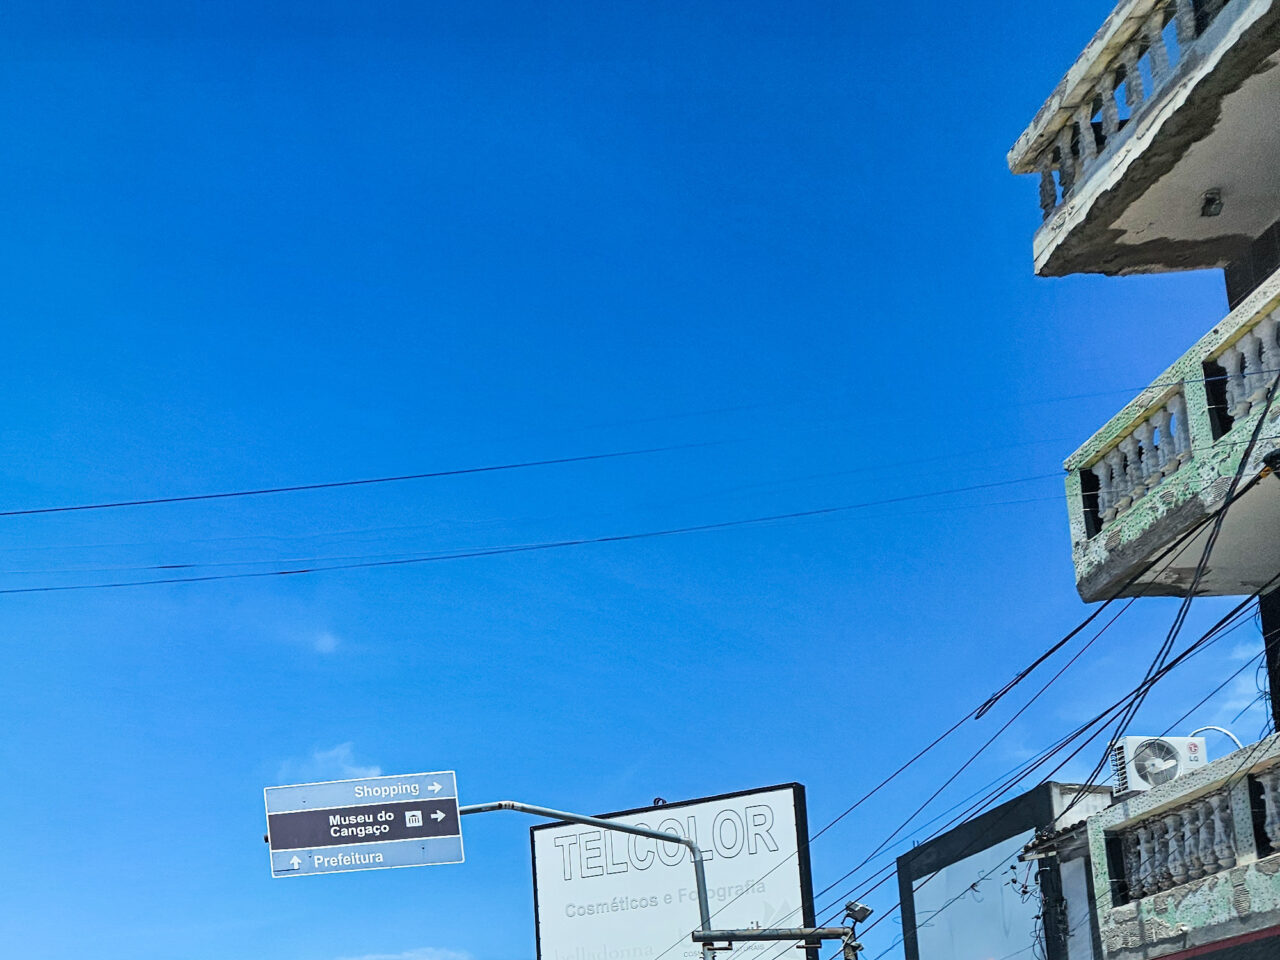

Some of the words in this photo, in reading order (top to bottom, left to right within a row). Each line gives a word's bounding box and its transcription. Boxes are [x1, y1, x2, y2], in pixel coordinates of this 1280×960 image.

[354, 783, 420, 798] Shopping
[329, 813, 374, 826] Museu
[377, 811, 395, 821] do
[330, 824, 390, 838] Cangaço
[554, 804, 779, 881] TELCOLOR
[314, 852, 384, 868] Prefeitura
[565, 895, 659, 918] Cosméticos
[663, 894, 673, 905] e
[678, 880, 766, 904] Foografia
